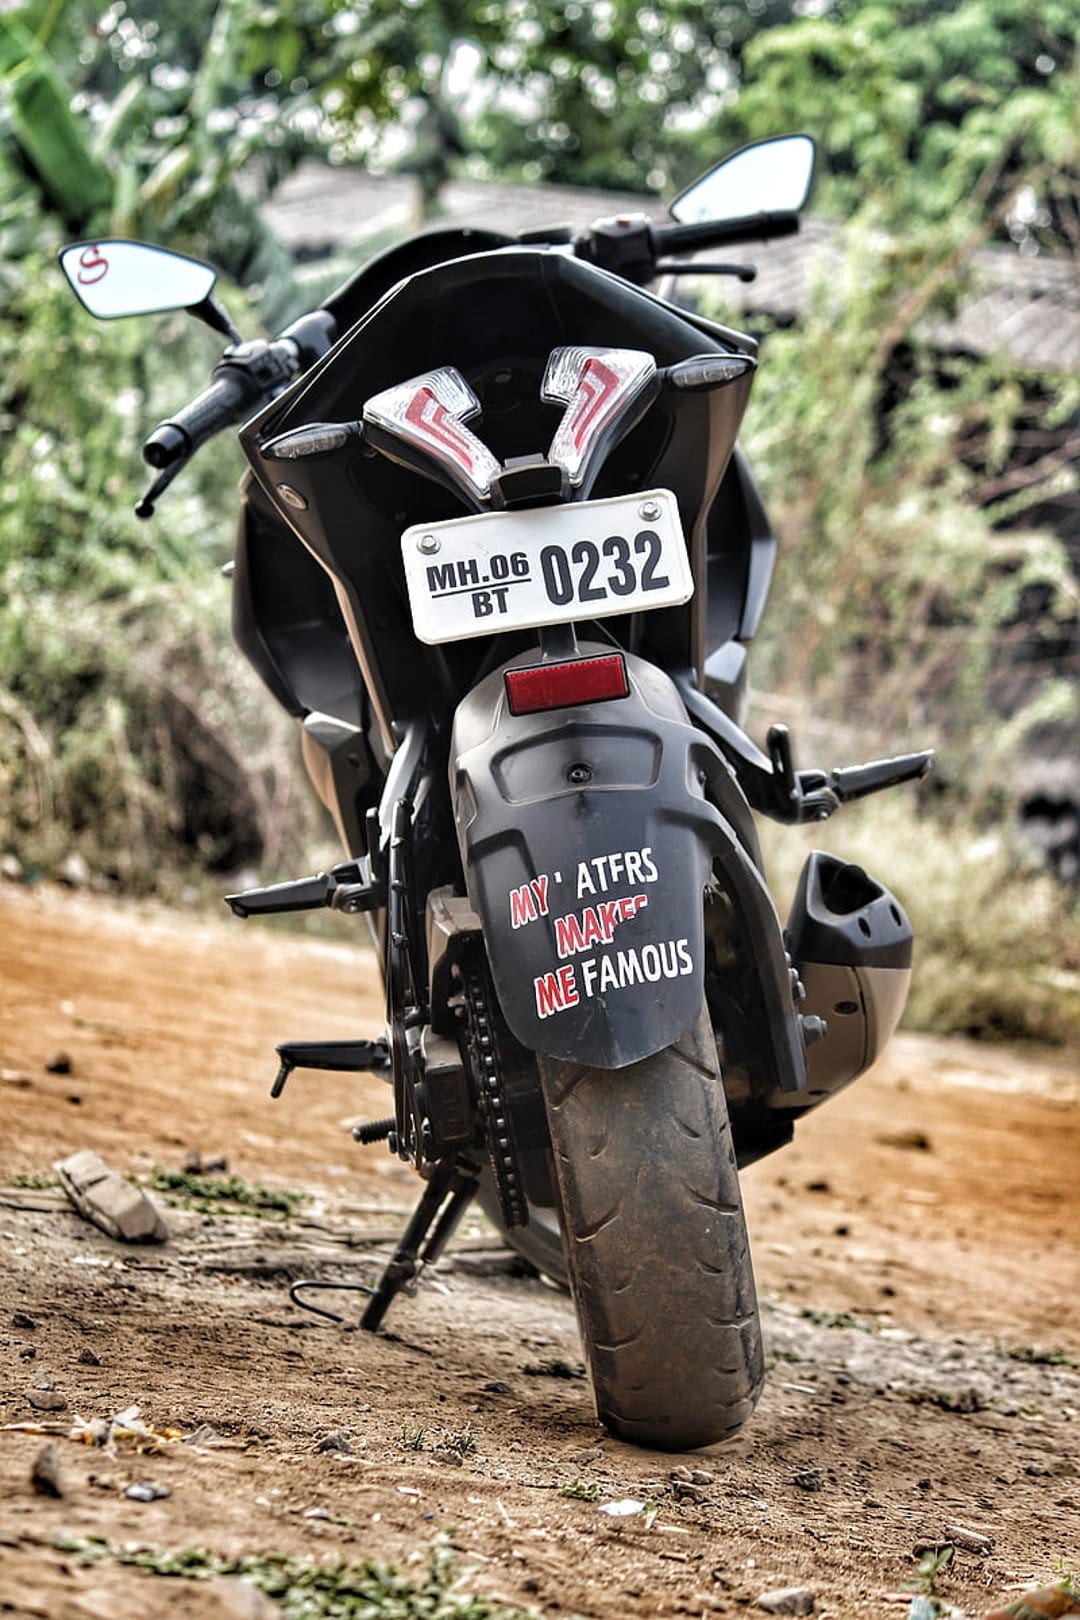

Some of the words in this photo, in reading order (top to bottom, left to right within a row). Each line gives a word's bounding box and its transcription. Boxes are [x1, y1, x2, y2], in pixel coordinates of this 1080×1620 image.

[426, 551, 530, 592] MH.06
[540, 530, 670, 606] 0232
[471, 587, 510, 618] BT
[510, 875, 549, 929] MY
[534, 964, 580, 1020] ME
[581, 939, 693, 998] FAMOUS
